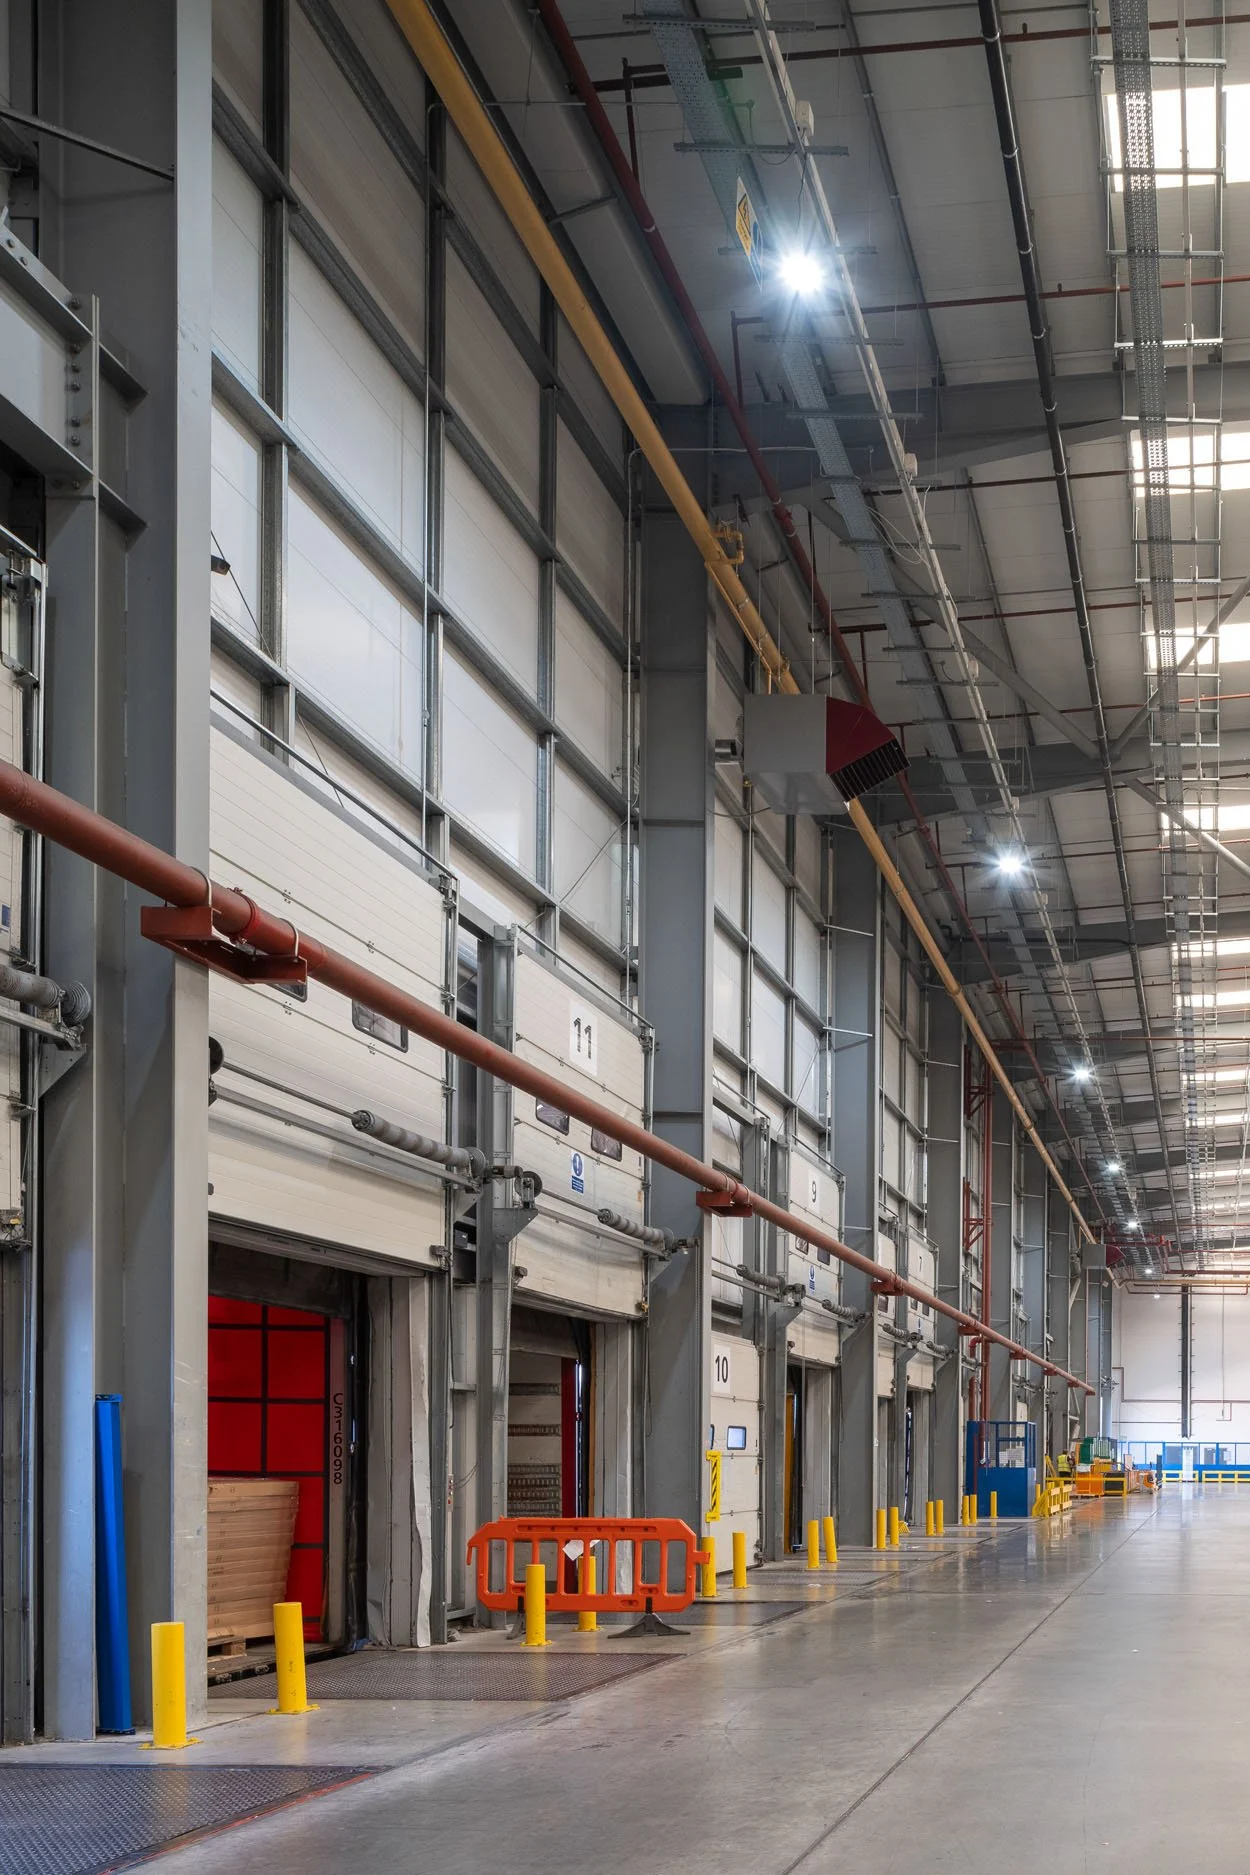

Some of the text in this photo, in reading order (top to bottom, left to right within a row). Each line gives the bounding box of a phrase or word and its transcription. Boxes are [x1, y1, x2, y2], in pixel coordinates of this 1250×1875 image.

[573, 1017, 592, 1059] 11
[811, 1181, 817, 1203] 9
[715, 1355, 728, 1383] 10
[333, 1393, 343, 1485] C316098
